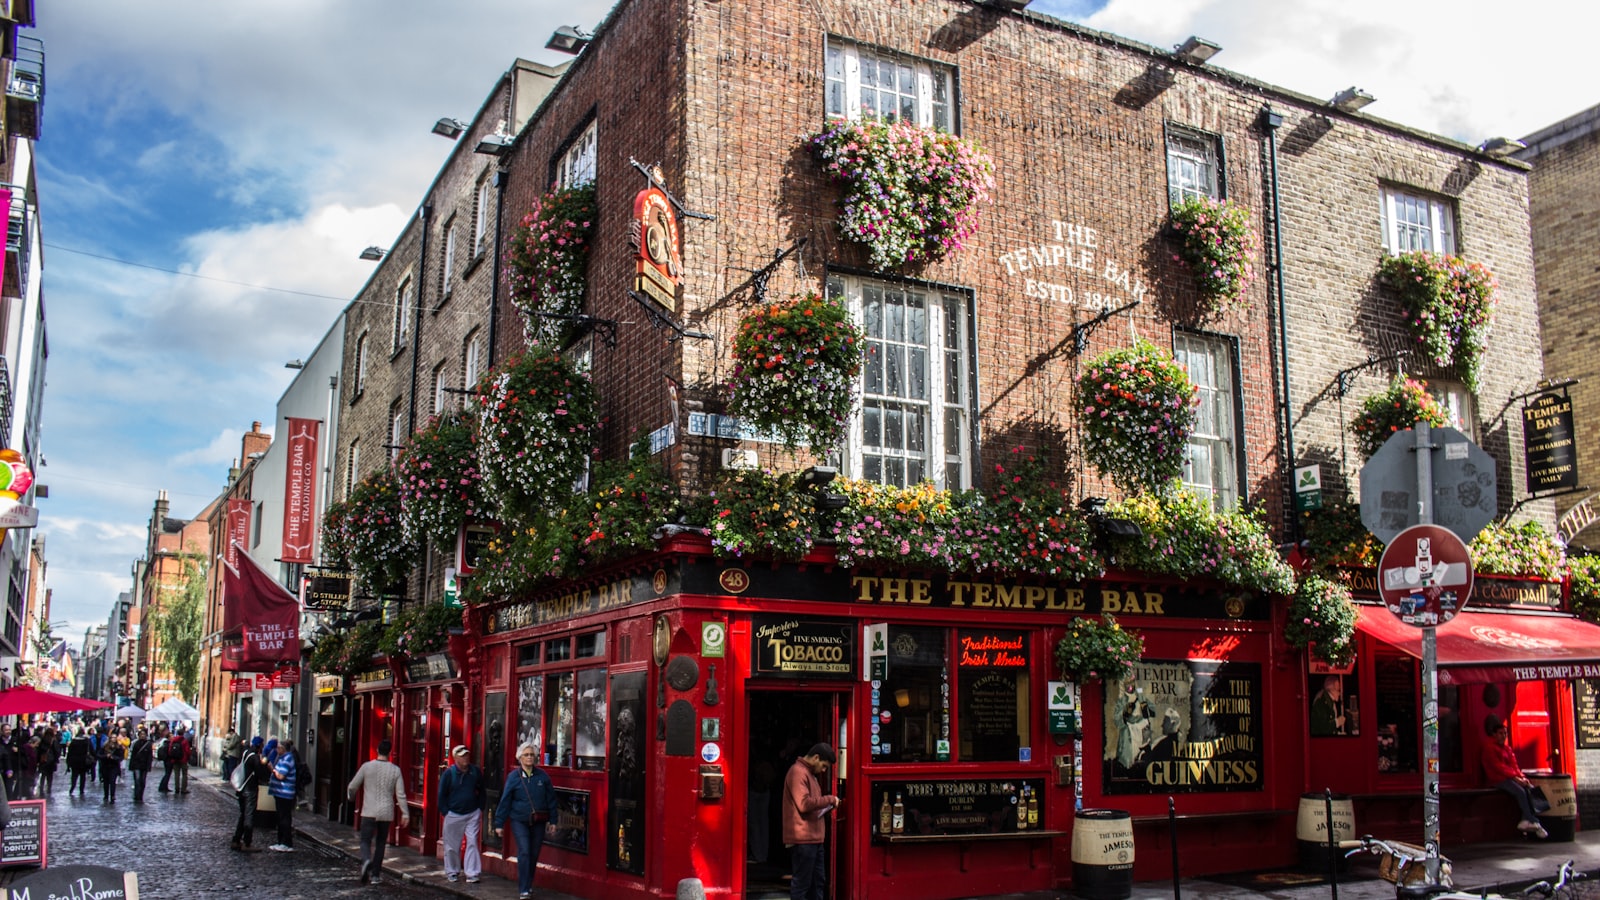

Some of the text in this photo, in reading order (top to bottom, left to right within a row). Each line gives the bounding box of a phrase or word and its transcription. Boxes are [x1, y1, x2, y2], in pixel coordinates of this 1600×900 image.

[1052, 219, 1098, 249] THE
[999, 245, 1147, 303] TEMPLE BAR
[1538, 397, 1554, 407] THE
[1525, 403, 1571, 420] TEMPLE
[1535, 416, 1560, 430] BAR
[1545, 438, 1572, 451] GARDEN
[1531, 464, 1572, 478] LIVE MUSIC
[1540, 475, 1562, 484] DAILY
[289, 444, 304, 539] THE TEMPLE BAR
[302, 483, 311, 523] TRADING
[1560, 499, 1596, 539] THE
[655, 572, 665, 589] 48
[725, 572, 743, 586] 48
[536, 588, 593, 621] TEMPLE
[599, 578, 633, 608] BAR
[853, 576, 1164, 615] THE TEMPLE BAR
[246, 630, 295, 643] TEMPLE
[756, 619, 799, 639] Importers
[259, 640, 284, 650] BAR
[811, 636, 842, 644] SMOKING
[961, 635, 1023, 650] Traditional
[767, 638, 843, 668] TOBACCO
[960, 651, 1026, 667] Irish Music
[783, 661, 848, 671] Always in Stock
[1513, 667, 1537, 680] THE
[1538, 666, 1582, 680] TEMPLE
[1132, 667, 1188, 682] TEMPLE
[1151, 682, 1177, 696] BAR
[1229, 679, 1251, 696] THE
[1202, 697, 1251, 714] EMPEROR
[1239, 716, 1251, 733] OF
[1172, 734, 1255, 759] MALTED LIQUORS
[1146, 759, 1258, 785] GUINNESS
[906, 783, 934, 797] THE
[936, 782, 987, 796] TEMPLE
[948, 796, 975, 805] DUBLIN
[6, 819, 37, 828] OFFEE
[936, 816, 950, 825] LIVE
[969, 816, 986, 824] DAILY
[4, 843, 37, 852] DONUTS
[76, 877, 124, 900] Rome
